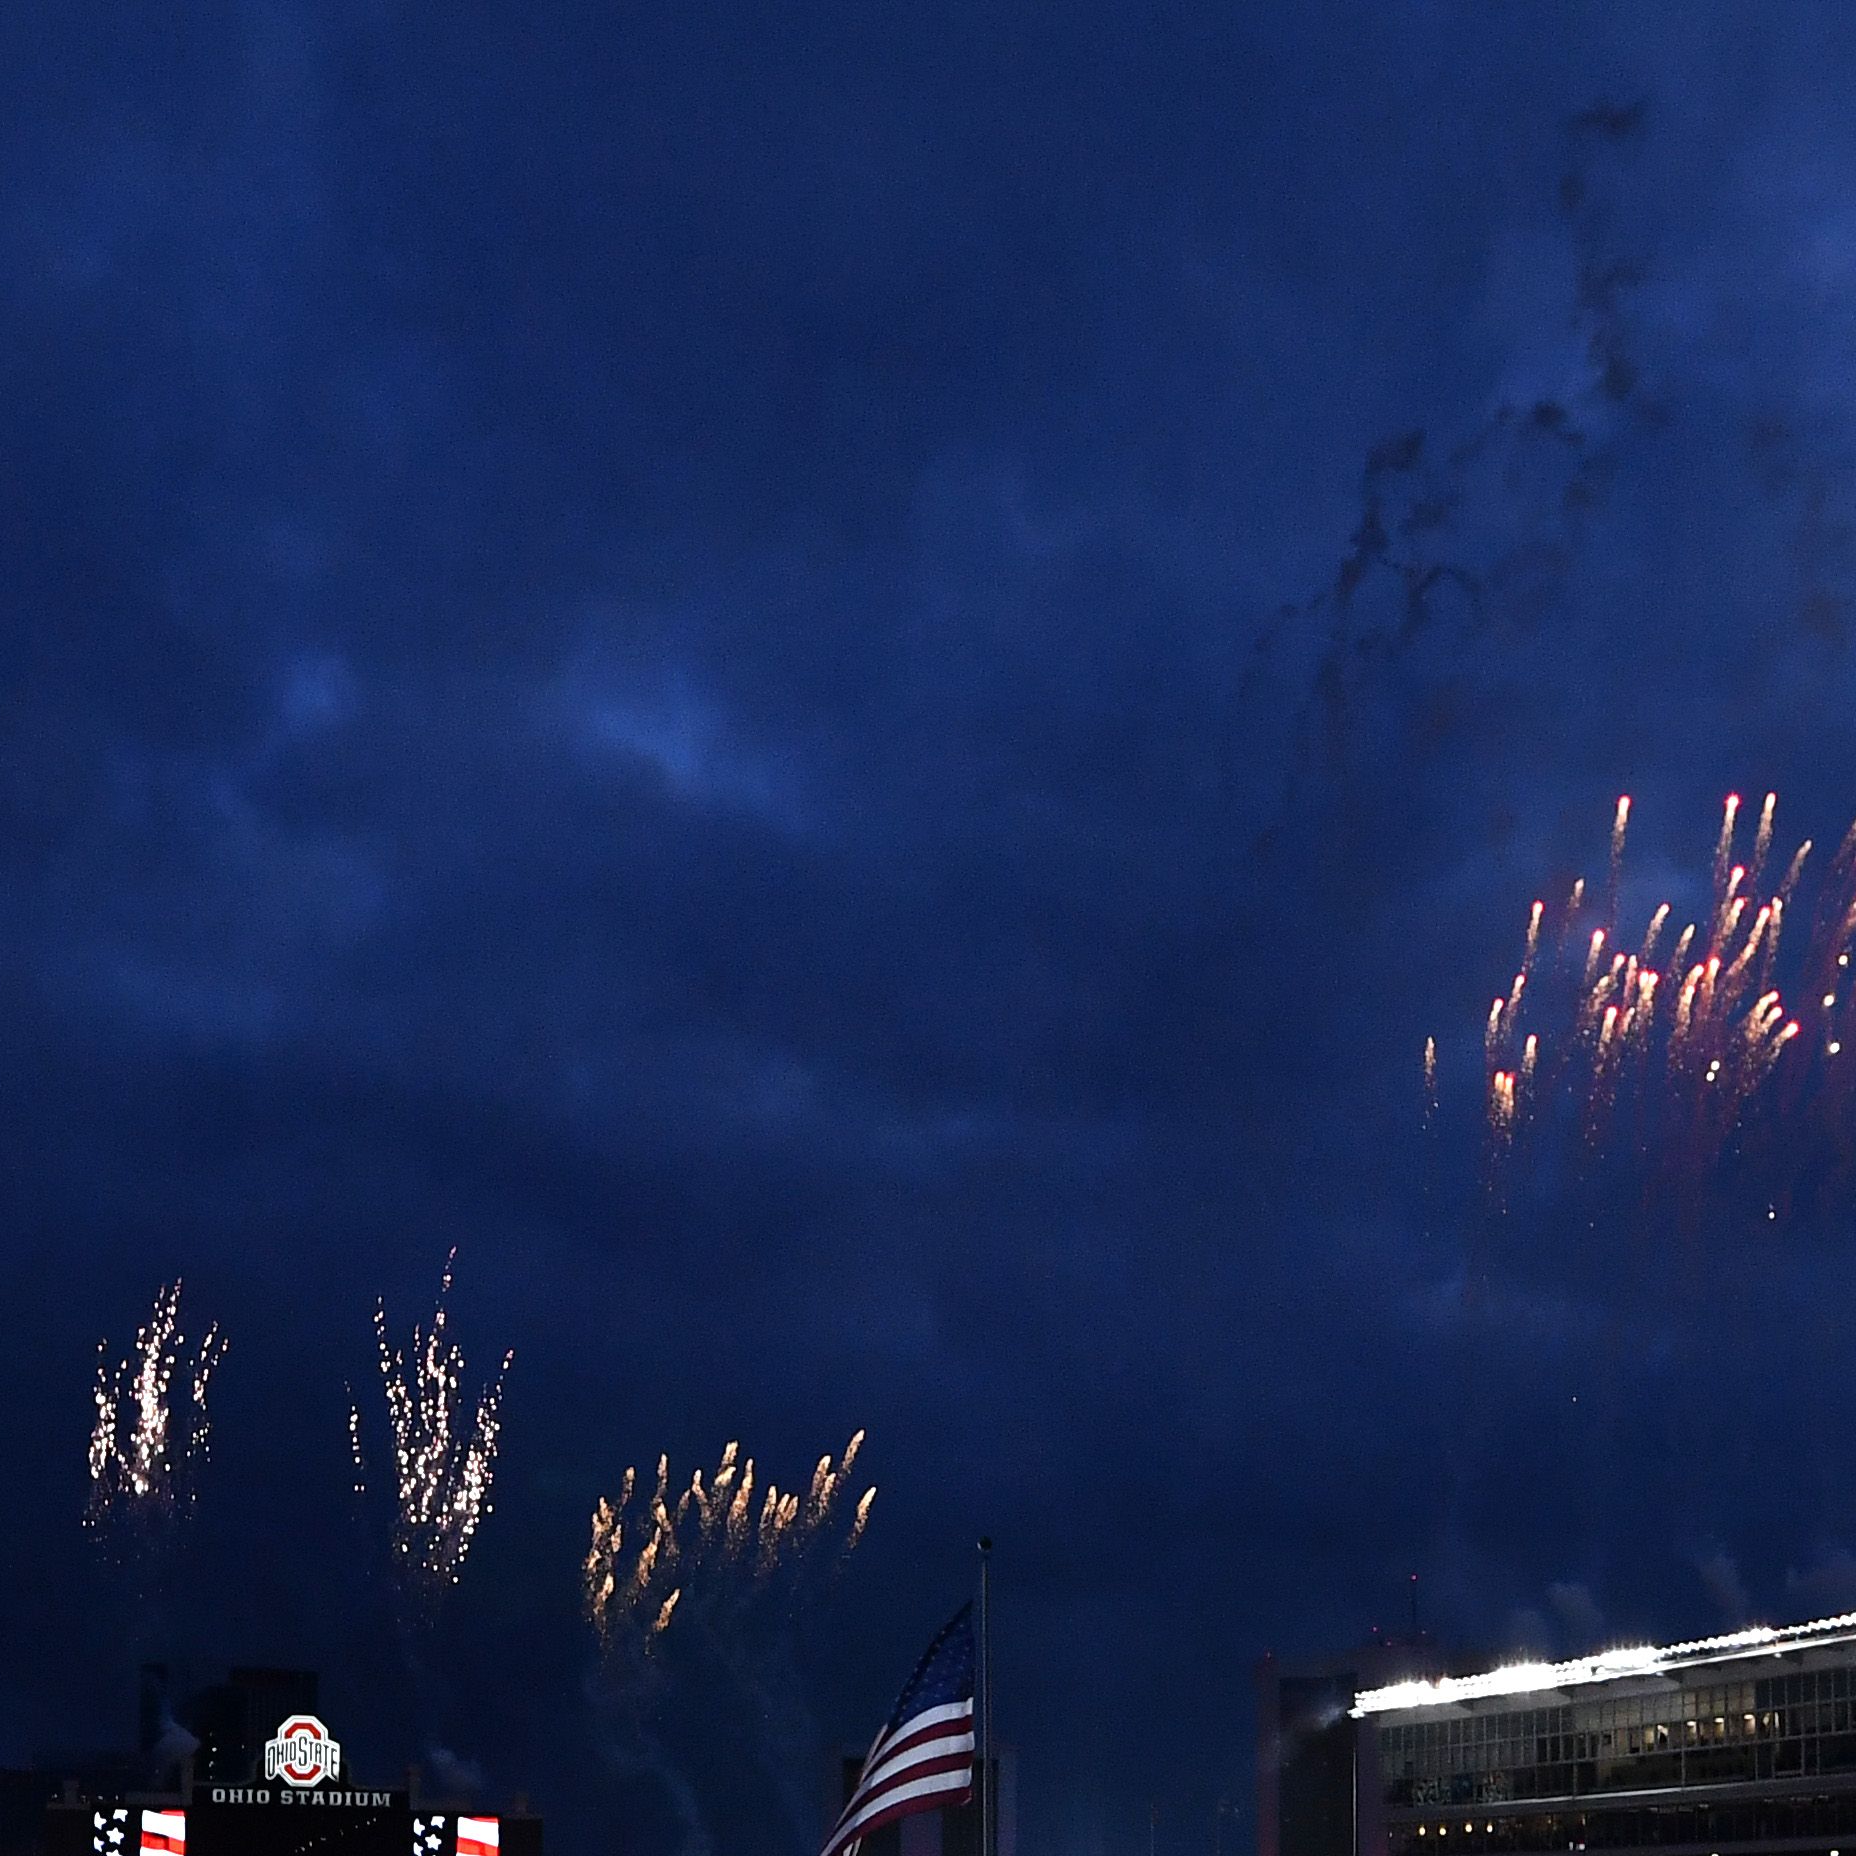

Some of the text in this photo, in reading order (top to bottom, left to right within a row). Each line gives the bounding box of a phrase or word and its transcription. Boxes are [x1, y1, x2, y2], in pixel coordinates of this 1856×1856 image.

[266, 1737, 340, 1779] OHIO STATE
[212, 1788, 391, 1807] OHIO STADIUM
